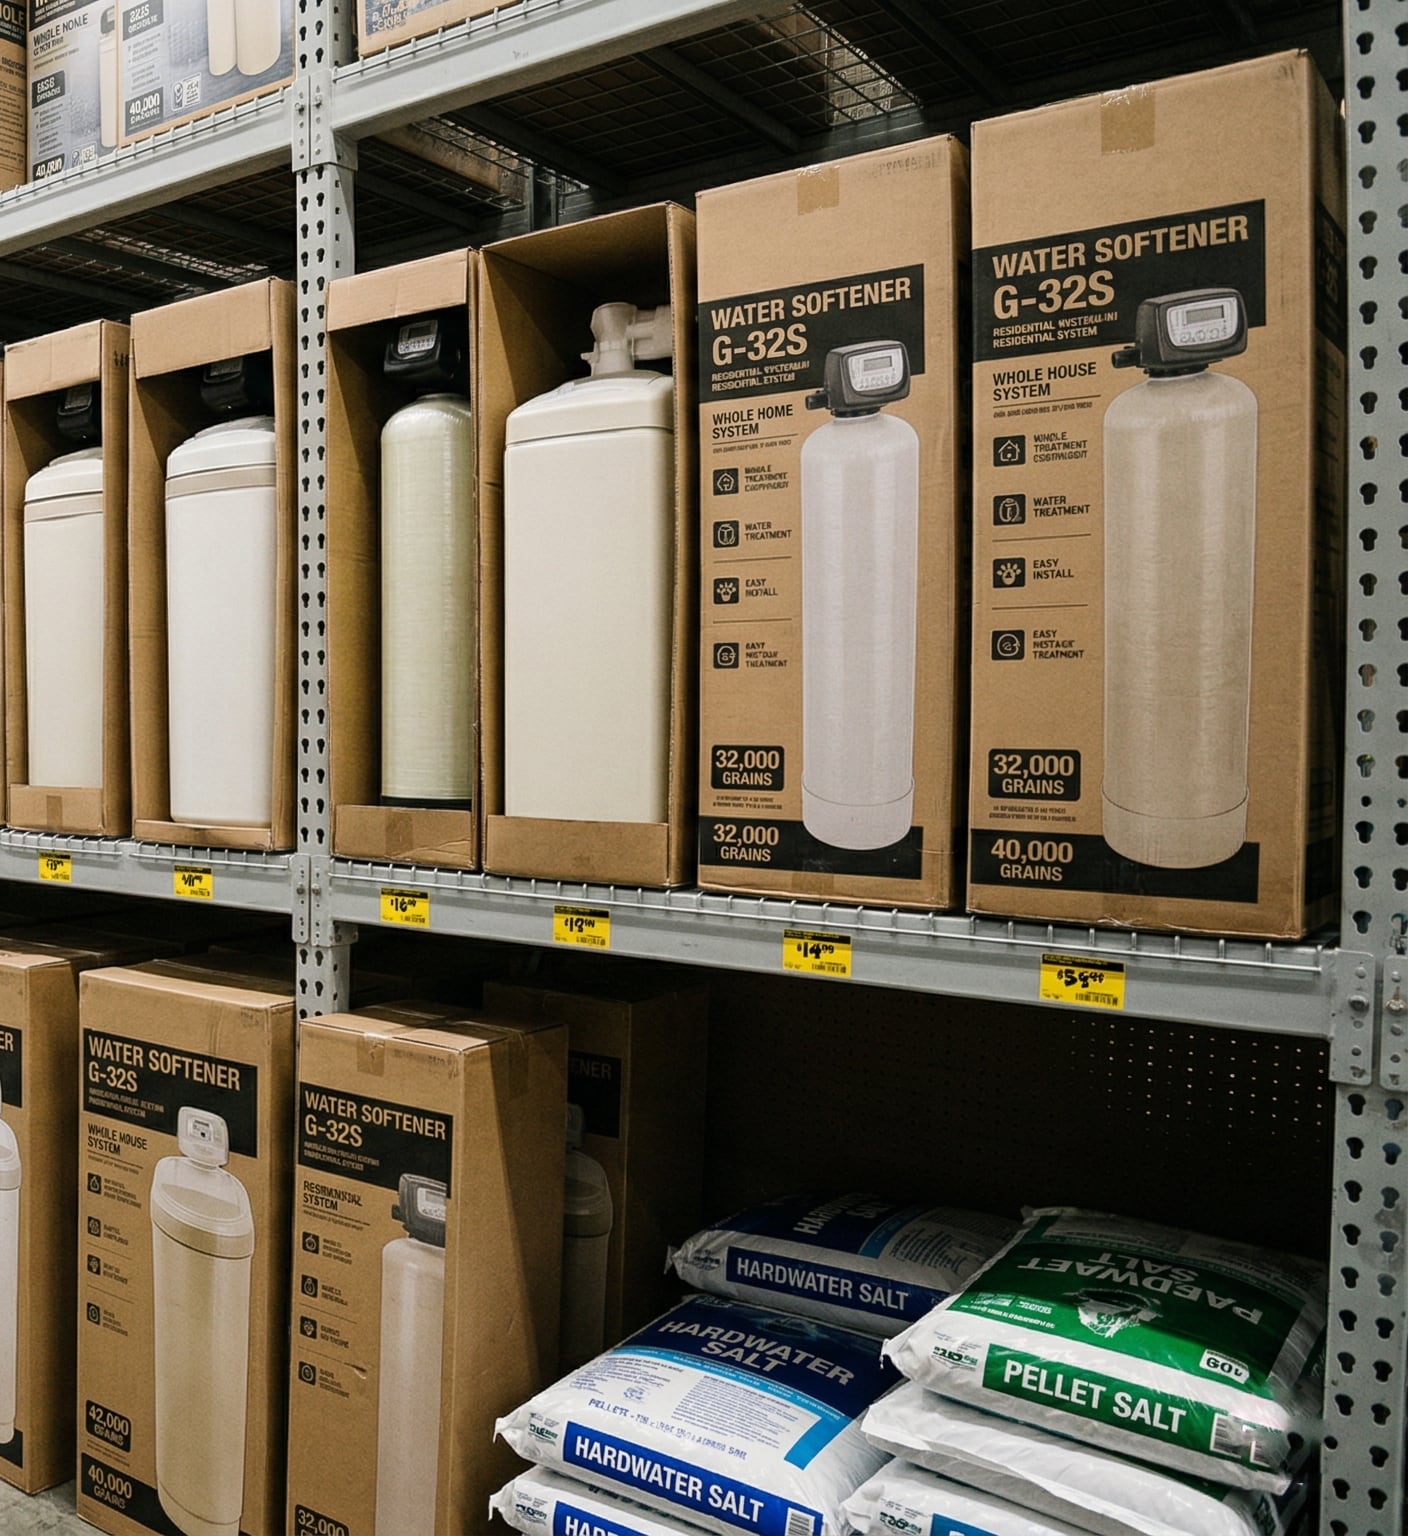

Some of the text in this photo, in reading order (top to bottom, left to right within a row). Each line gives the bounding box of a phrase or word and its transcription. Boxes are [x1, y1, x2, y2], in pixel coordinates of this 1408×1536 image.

[992, 214, 1249, 280] WATER SOFTENER
[711, 276, 911, 331] WATER SOFTENER
[993, 270, 1115, 320] G-32S
[993, 320, 1056, 337] RESIDENTIAL
[1057, 326, 1098, 340] SYSTEM
[712, 323, 808, 366] G-32S
[992, 361, 1097, 387] WHOLE HOUSE
[992, 382, 1051, 402] SYSTEM
[712, 404, 794, 426] WHOLE HOME
[712, 422, 759, 440] SYSTEM
[1033, 495, 1067, 507] WATER
[1033, 558, 1059, 569] EASY
[1033, 568, 1075, 580] INSTALL
[1033, 629, 1058, 639] EASY
[716, 749, 780, 772] 32,000
[993, 754, 1075, 779] 32,000
[722, 771, 773, 787] GRAINS
[1001, 778, 1065, 796] GRAINS
[713, 823, 780, 848] 32,000
[720, 845, 772, 863] GRAINS
[991, 837, 1074, 865] 40,000
[999, 863, 1063, 882] GRAINS
[88, 1035, 241, 1092] WATER SOFTENER
[88, 1061, 138, 1094] G-32S
[304, 1090, 447, 1141] WATER SOFTENER
[304, 1114, 364, 1148] G-32S
[1088, 1252, 1200, 1284] SALT
[736, 1256, 910, 1311] HARDWATER SALT
[657, 1320, 856, 1387] HARDWATER
[700, 1341, 789, 1373] SALT
[1002, 1358, 1188, 1434] PELLET SALT
[575, 1435, 704, 1502] HARDWATER
[708, 1484, 765, 1524] SALT
[298, 1509, 345, 1536] 32,000
